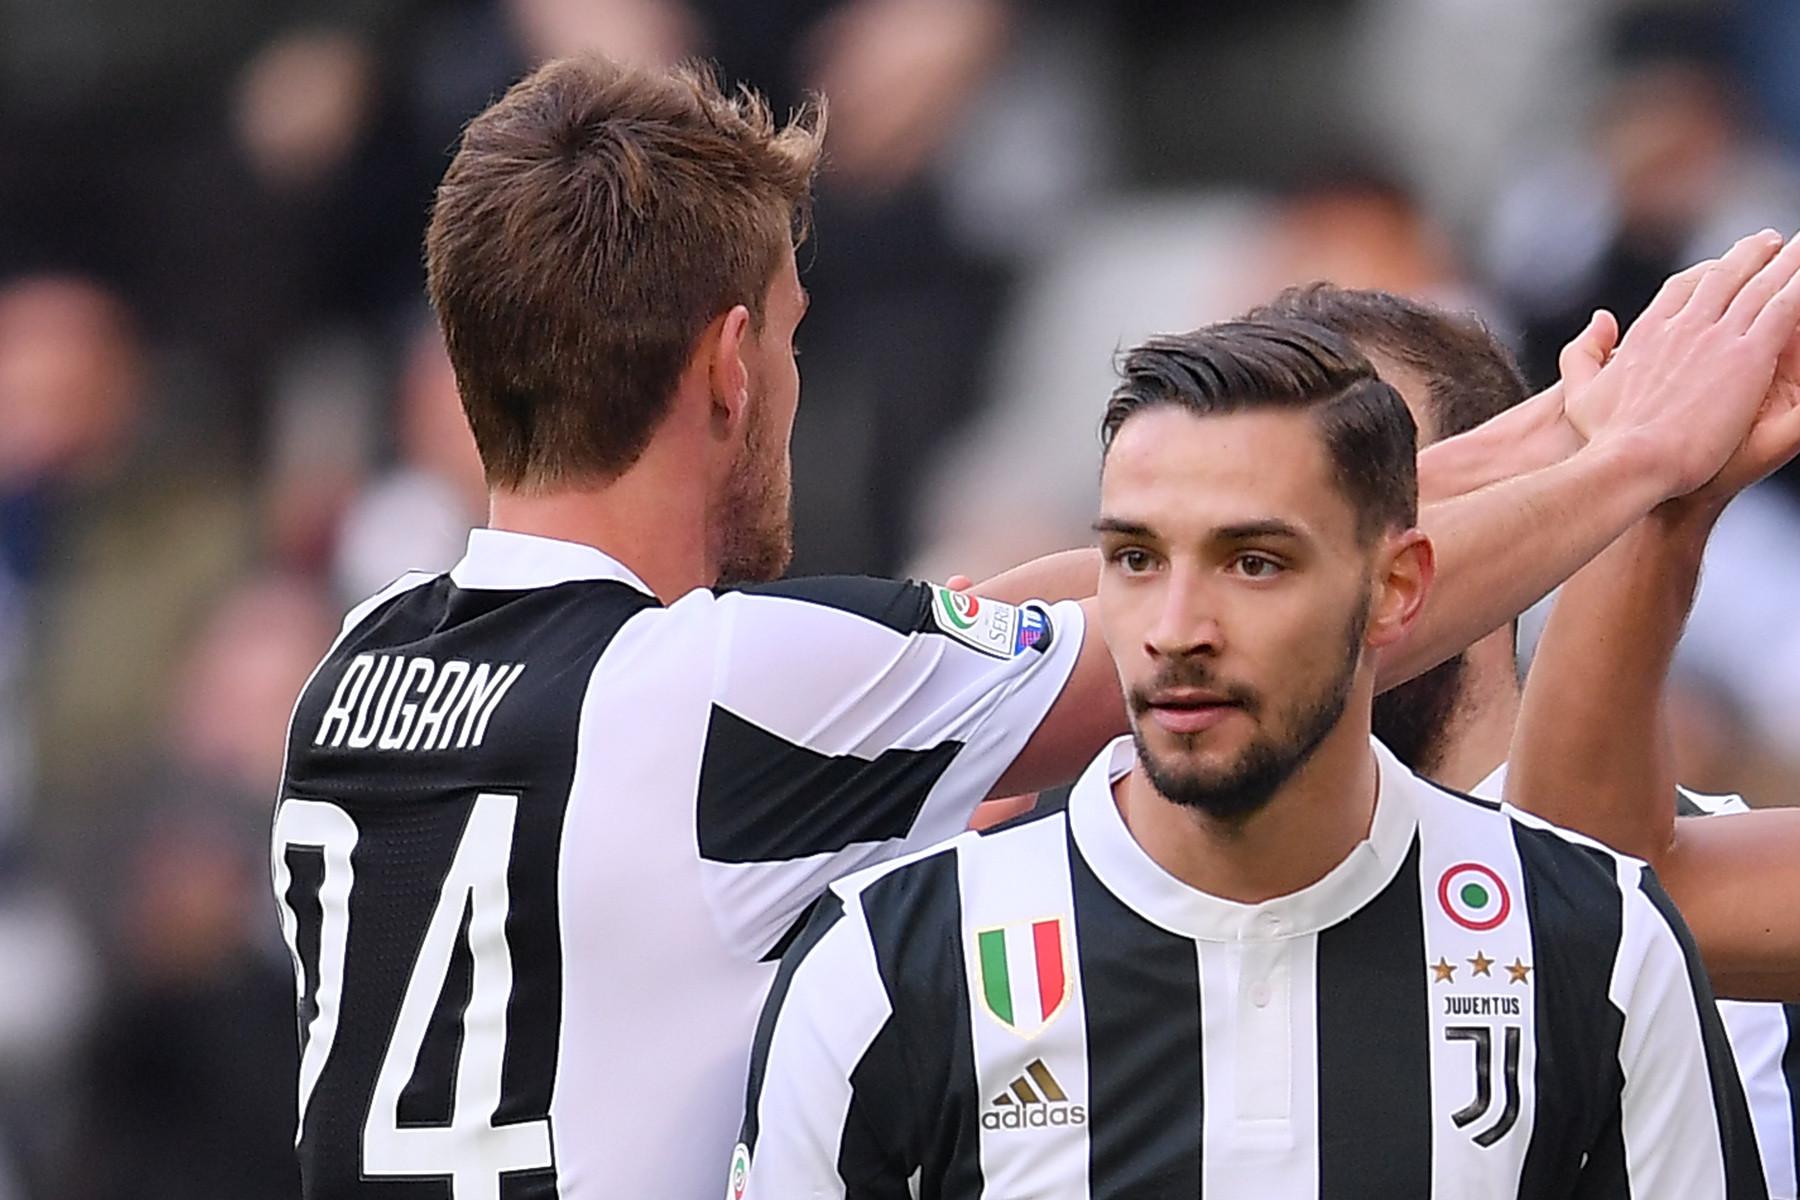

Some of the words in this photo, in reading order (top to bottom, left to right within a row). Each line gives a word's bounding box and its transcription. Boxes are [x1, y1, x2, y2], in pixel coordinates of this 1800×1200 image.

[314, 654, 526, 750] RUGANI
[1444, 997, 1520, 1015] JUVENTUS
[982, 1103, 1086, 1130] adidas
